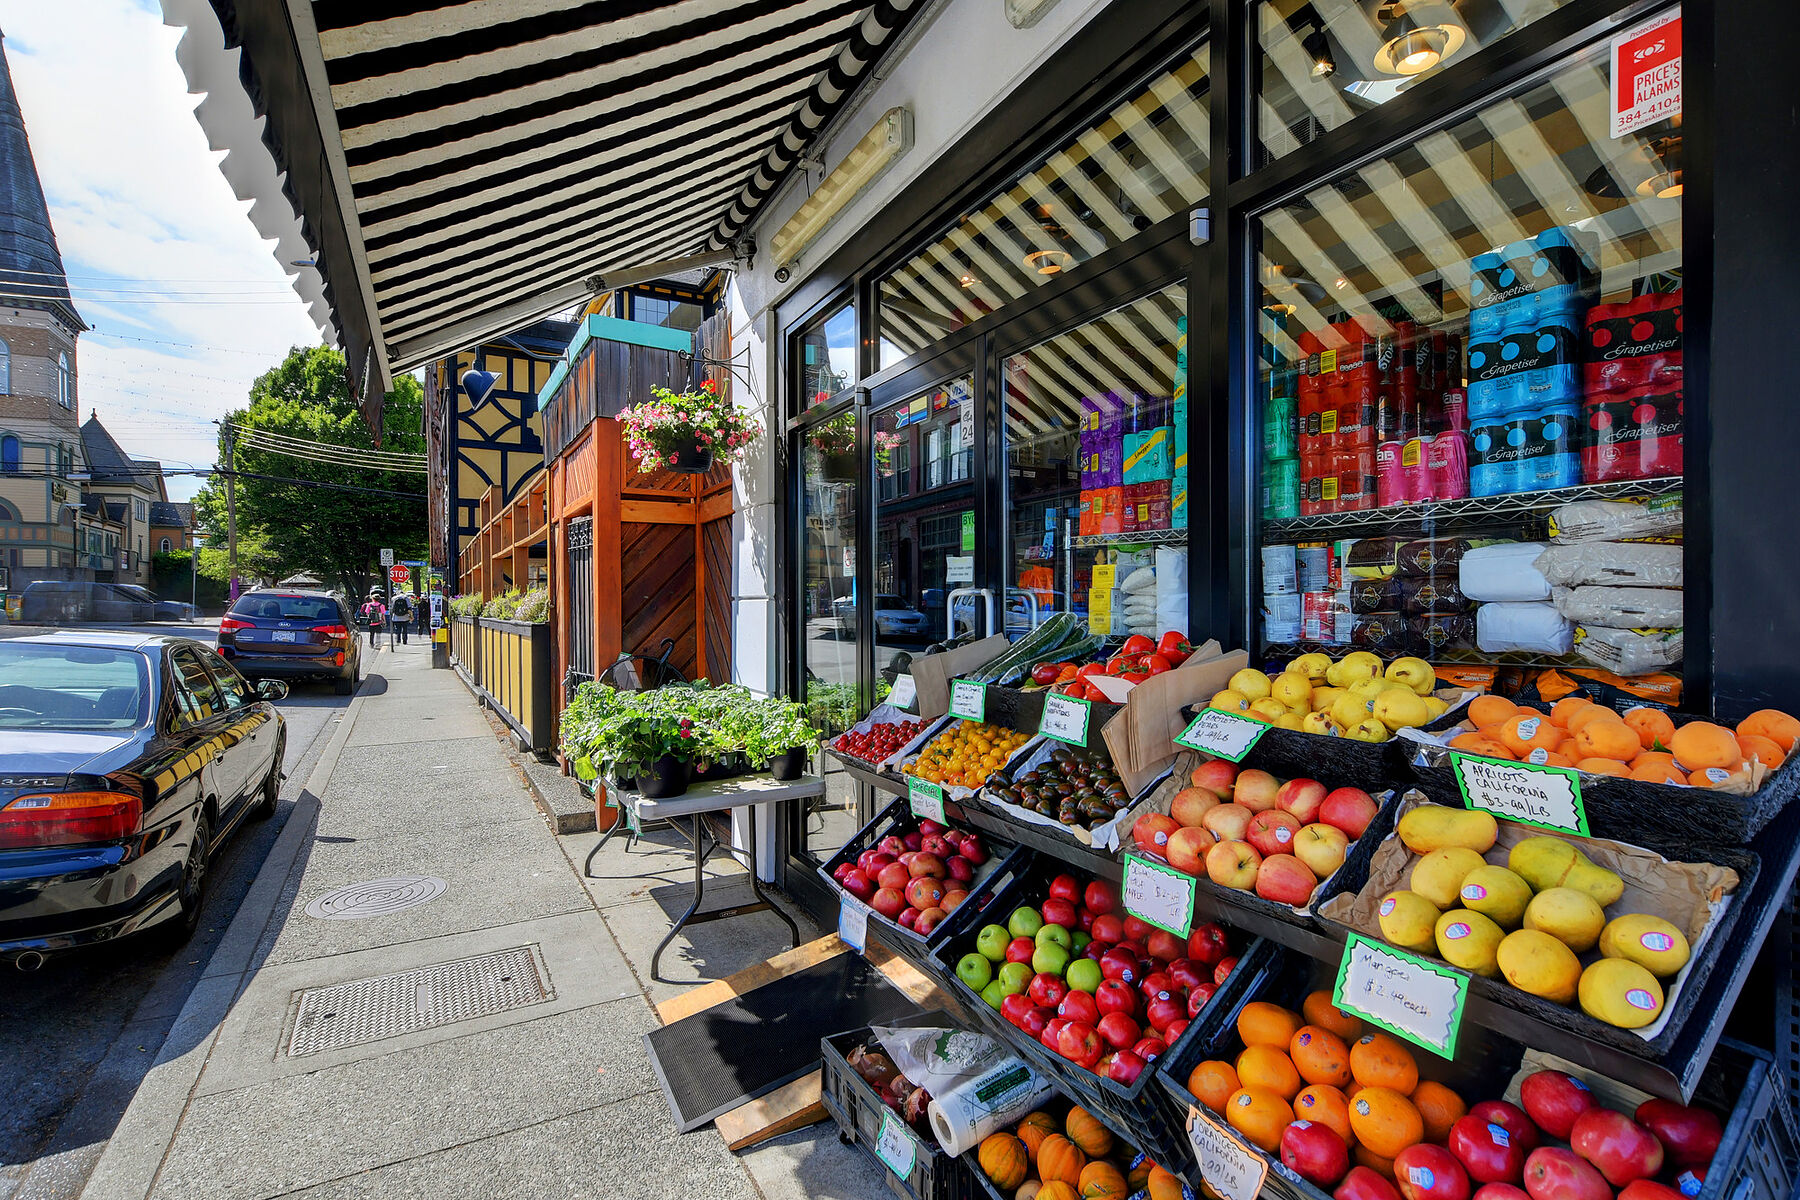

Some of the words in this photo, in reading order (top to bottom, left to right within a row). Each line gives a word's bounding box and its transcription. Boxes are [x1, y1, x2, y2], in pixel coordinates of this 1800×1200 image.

[1629, 19, 1660, 39] Protected
[1661, 16, 1670, 26] by
[1636, 61, 1680, 90] PRICE'S
[1636, 76, 1680, 104] ALARMS
[1618, 95, 1680, 127] 384-4104
[1479, 281, 1535, 307] Grapetiser
[1603, 336, 1679, 360] Grapetiser
[1480, 356, 1540, 380] Grapetiser
[962, 426, 974, 441] 24
[1604, 420, 1681, 444] Grapetiser
[1486, 443, 1547, 463] Grapetiser
[390, 570, 410, 578] STOP
[1472, 765, 1528, 783] APRICOTS
[912, 780, 940, 798] SPECIAL
[1199, 1124, 1239, 1158] ORANGES
